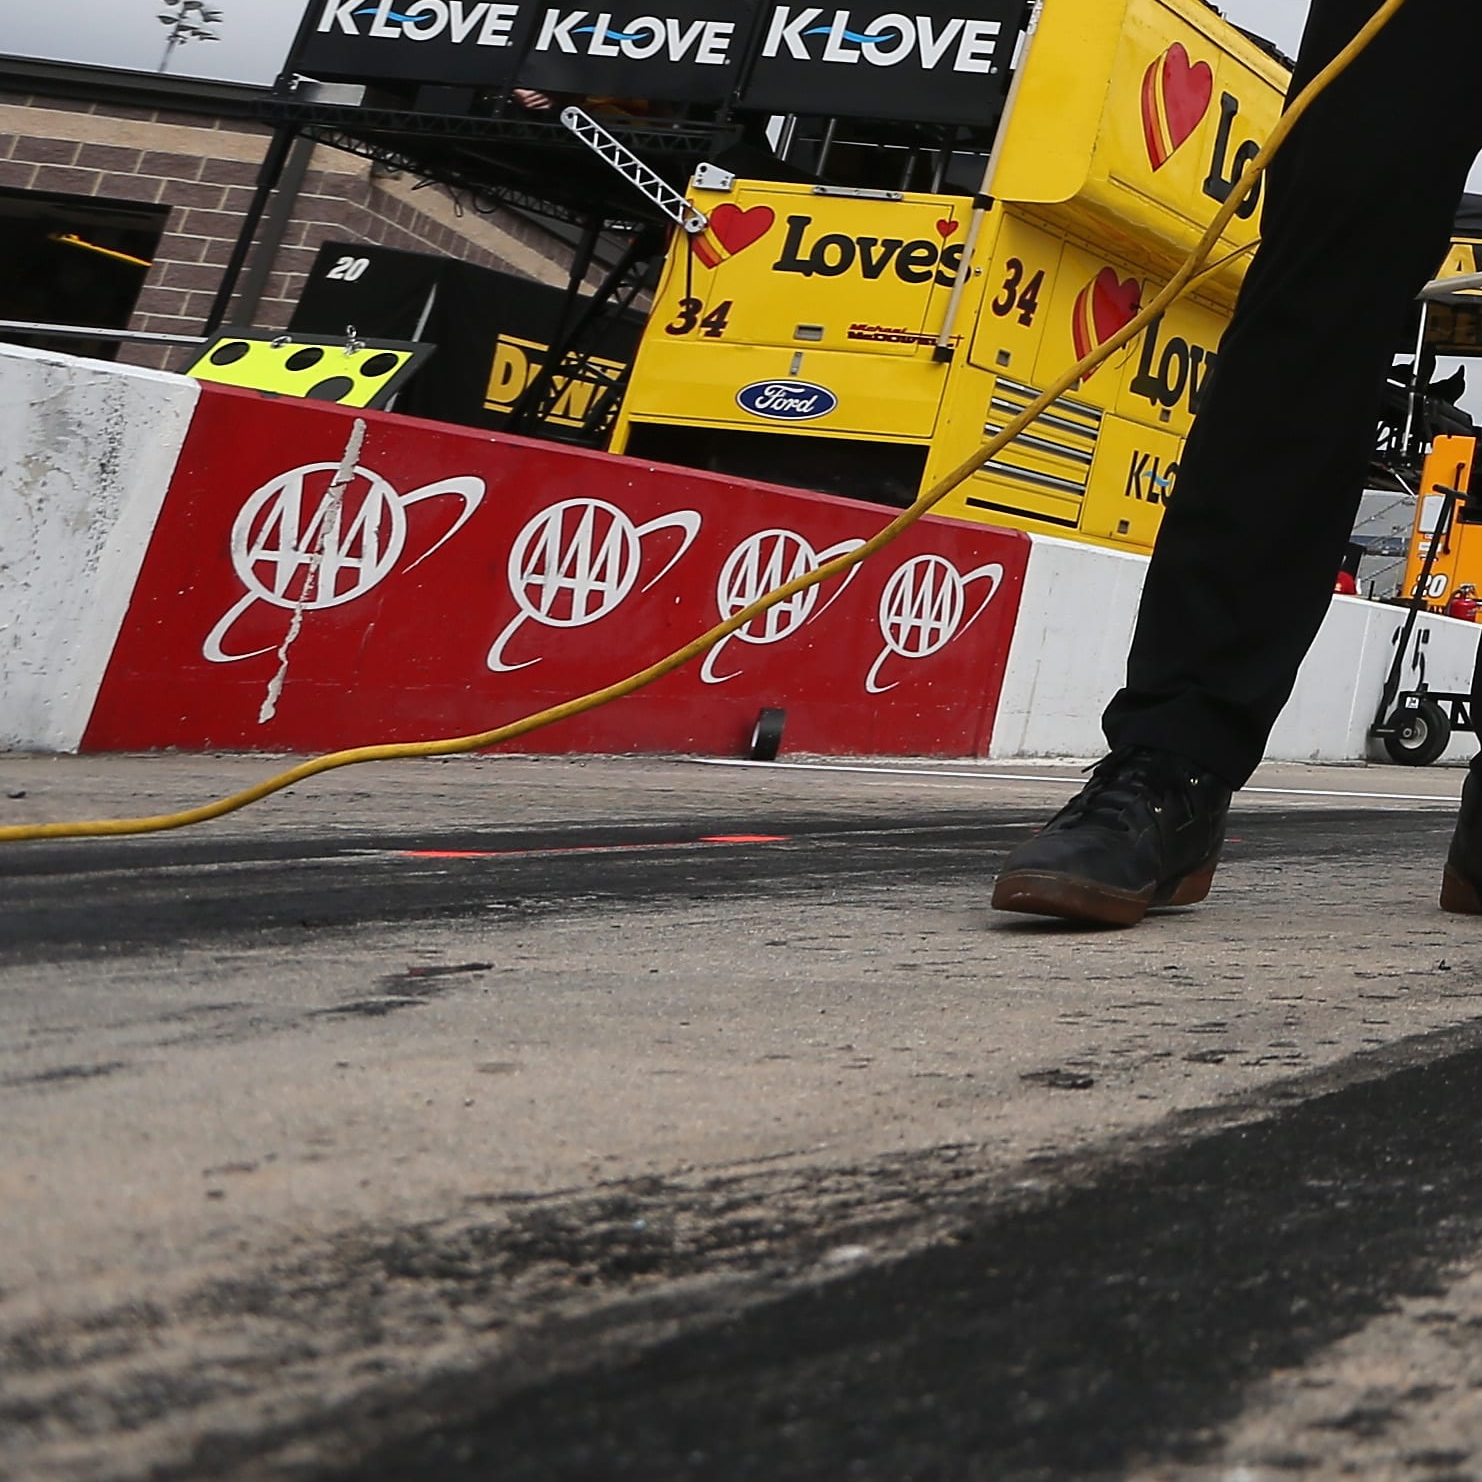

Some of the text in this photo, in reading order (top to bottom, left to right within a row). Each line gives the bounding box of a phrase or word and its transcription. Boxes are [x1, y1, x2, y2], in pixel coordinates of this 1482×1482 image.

[325, 256, 369, 281] 20
[992, 258, 1045, 327] 34
[665, 296, 733, 338] 34
[755, 385, 819, 414] Ford
[243, 466, 392, 608] AAA
[522, 500, 626, 625] AAA
[727, 531, 810, 641] AAA
[887, 556, 958, 655] AAA
